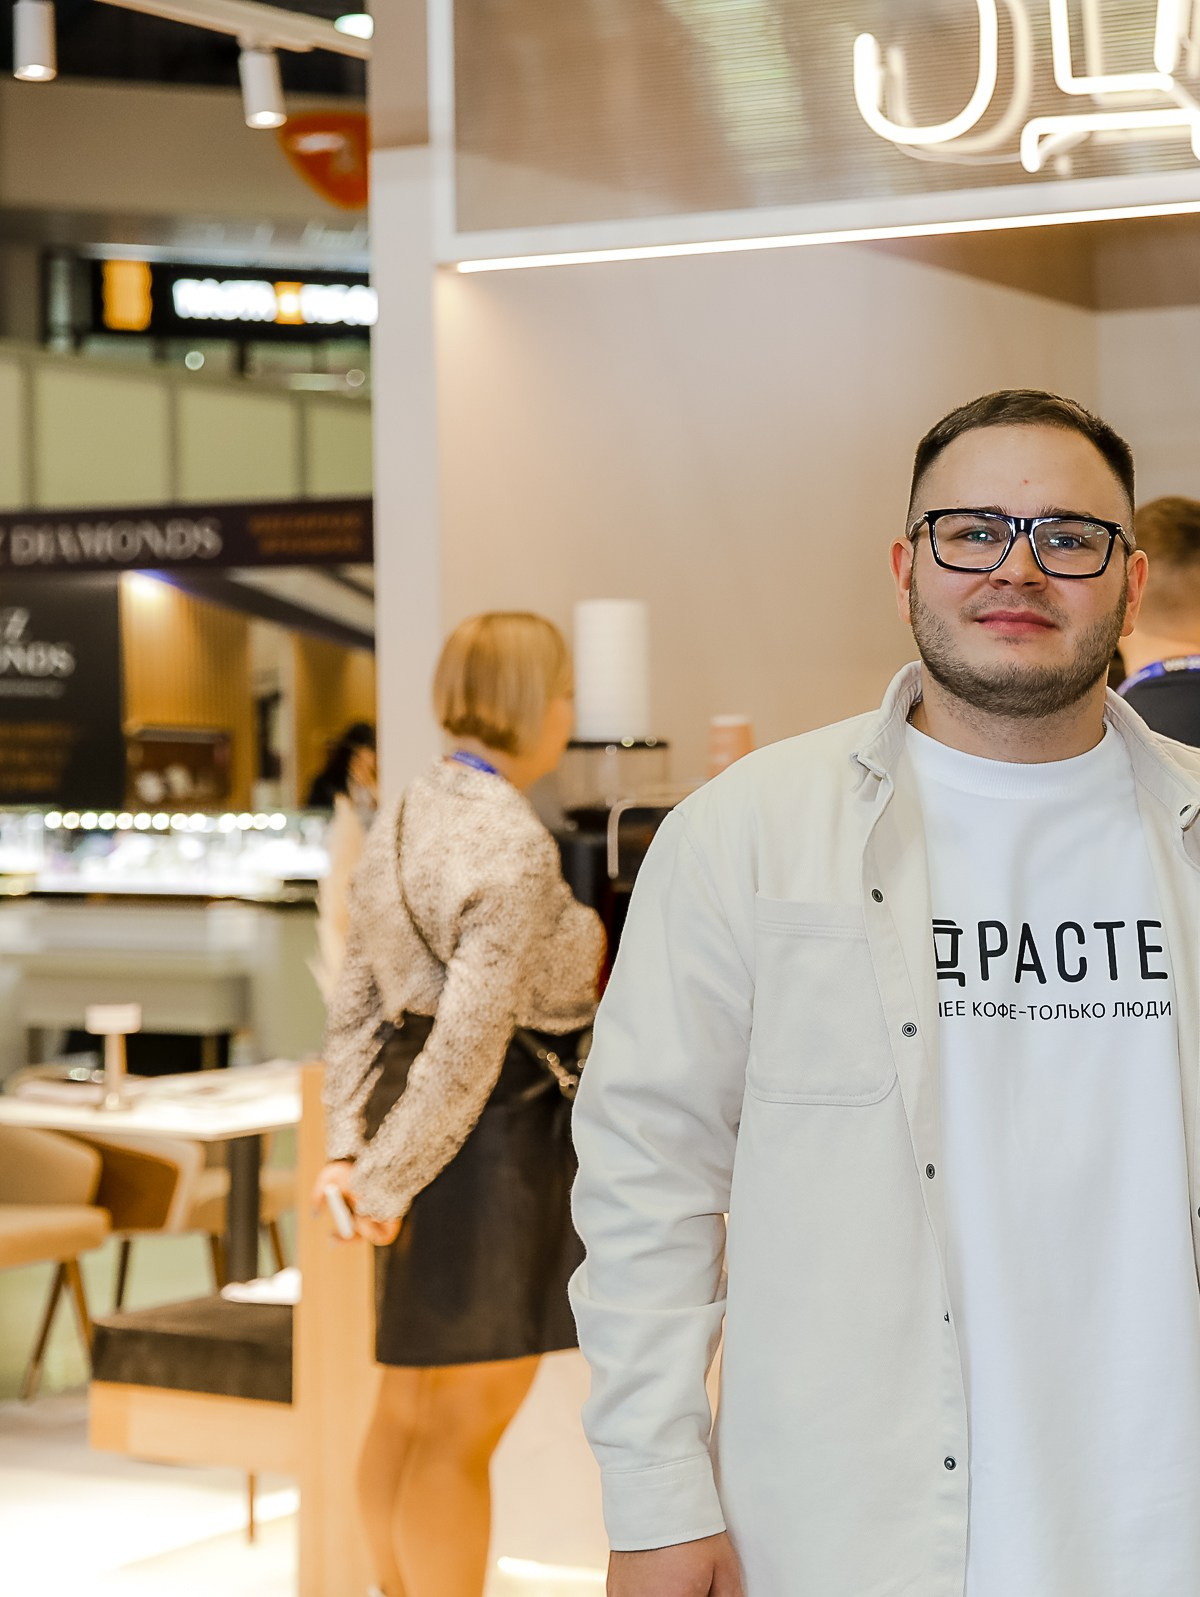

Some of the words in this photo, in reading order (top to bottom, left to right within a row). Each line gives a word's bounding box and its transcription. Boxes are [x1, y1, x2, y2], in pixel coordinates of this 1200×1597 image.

[10, 517, 223, 565] DIAMONDS
[0, 641, 76, 678] NDS
[1113, 1001, 1172, 1019] ЛЮДИ
